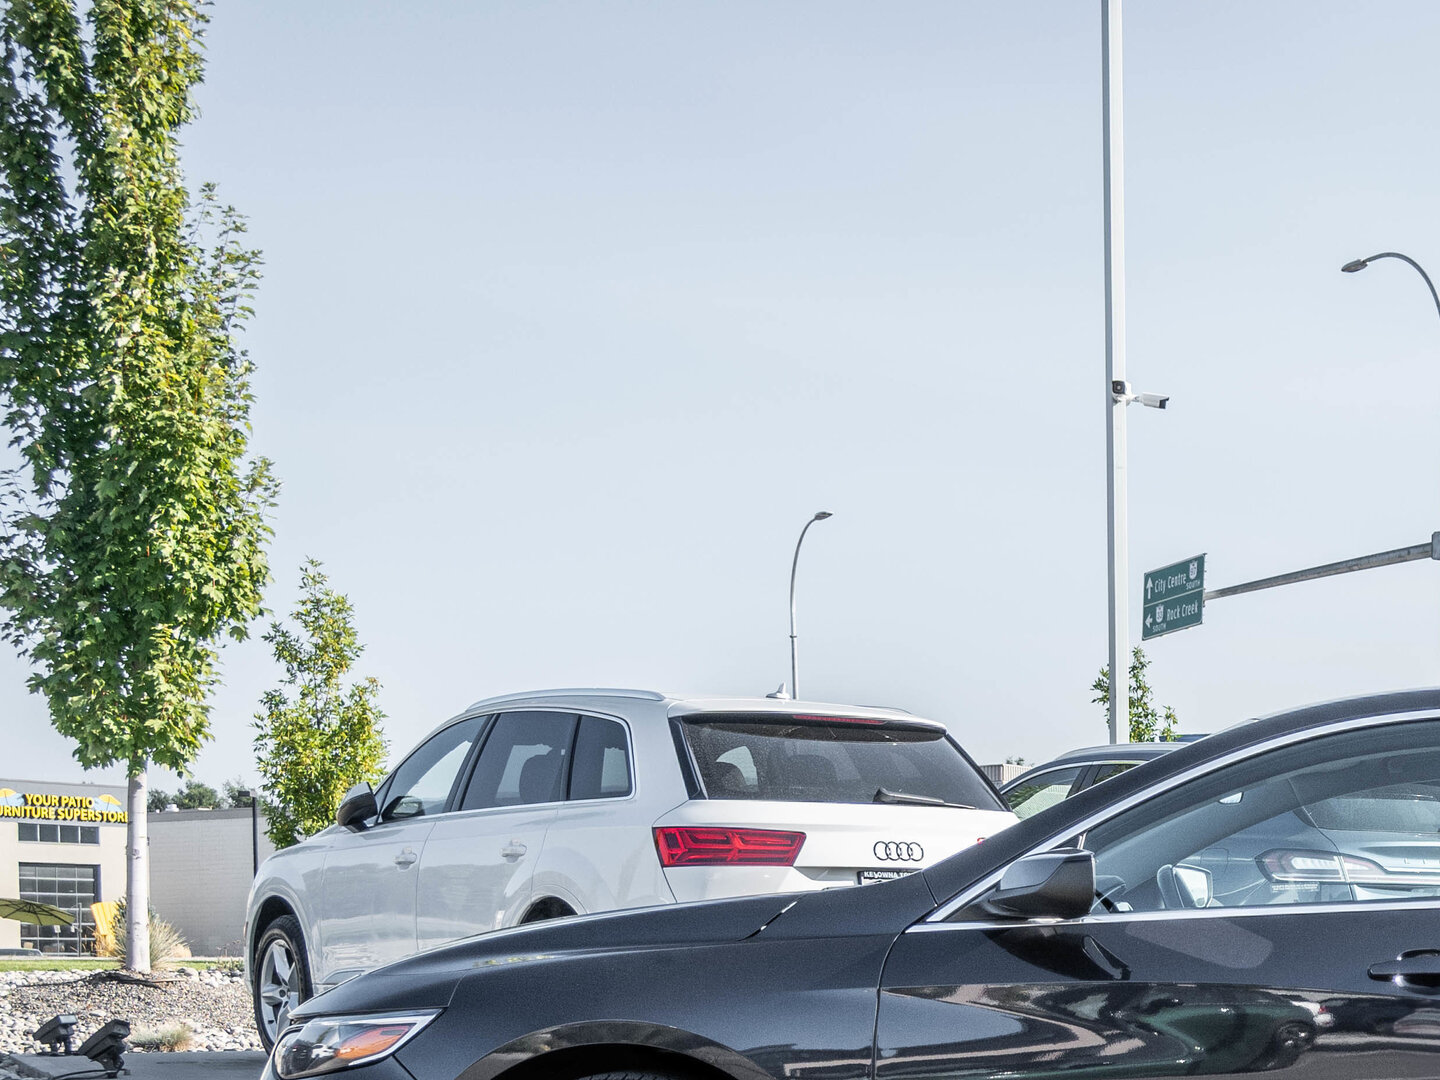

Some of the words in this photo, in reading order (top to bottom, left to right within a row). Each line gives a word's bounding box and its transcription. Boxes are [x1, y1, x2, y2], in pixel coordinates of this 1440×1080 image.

[1154, 578, 1166, 594] City
[1167, 573, 1187, 588] Centre
[1166, 605, 1180, 621] Rock
[1181, 600, 1199, 617] Creek
[25, 793, 59, 807] YOUR
[61, 796, 95, 808] PATIO
